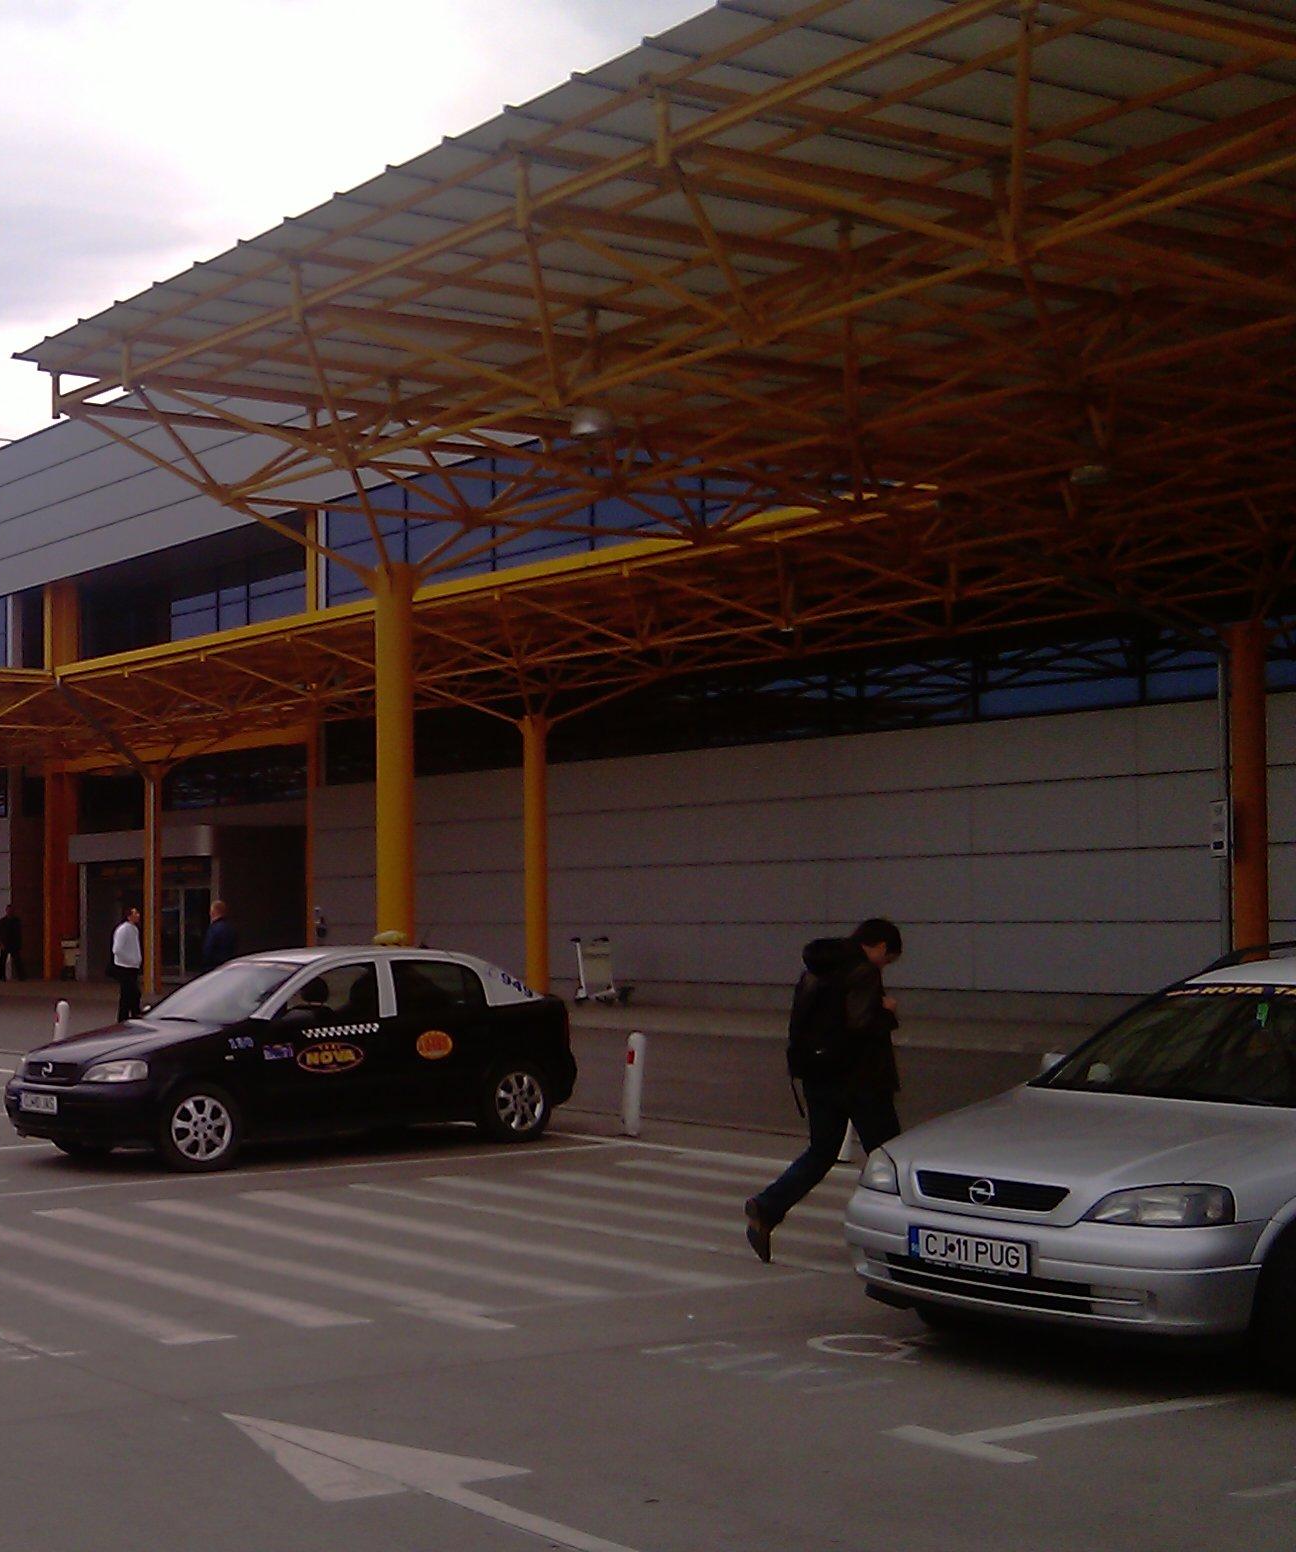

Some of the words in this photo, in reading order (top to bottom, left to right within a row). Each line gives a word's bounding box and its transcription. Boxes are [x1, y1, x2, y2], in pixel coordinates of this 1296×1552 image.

[1200, 986, 1265, 996] NOVA
[305, 1049, 356, 1066] NOVA
[974, 1241, 1021, 1269] PUG
